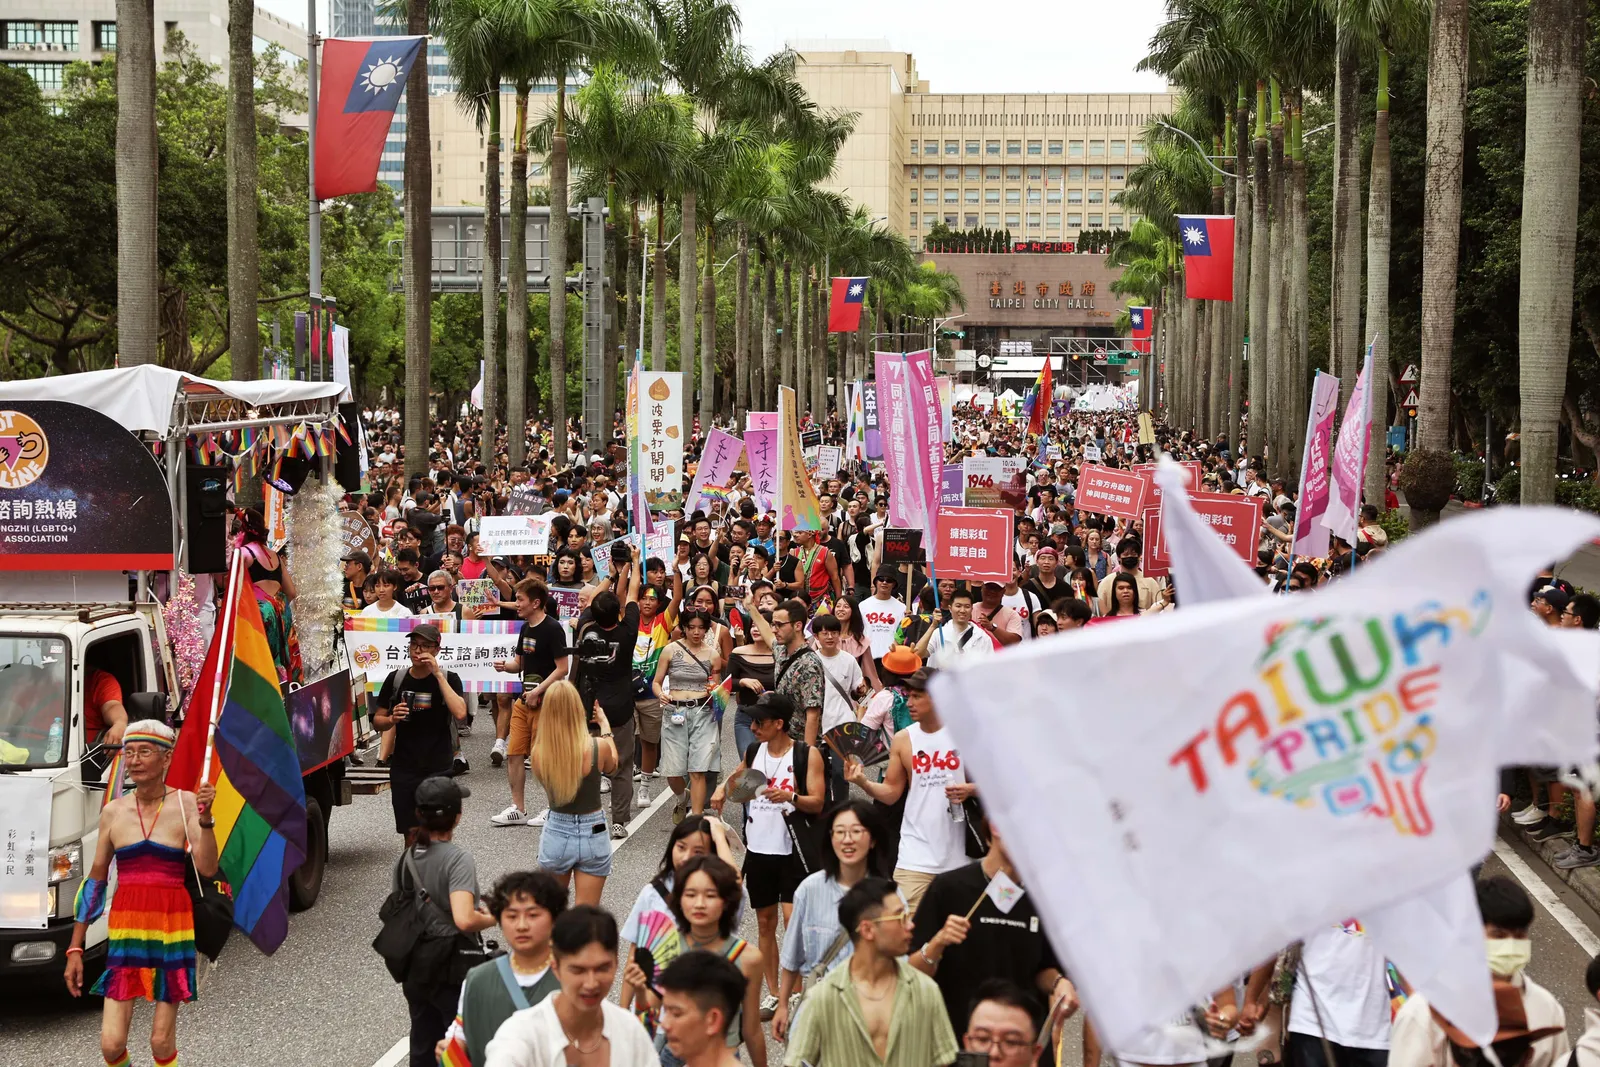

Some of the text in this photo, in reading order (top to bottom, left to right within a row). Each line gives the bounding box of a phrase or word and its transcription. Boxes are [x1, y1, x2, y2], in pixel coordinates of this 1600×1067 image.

[990, 280, 1096, 297] 臺北市政府
[989, 299, 1095, 309] TAIPEI CITY HALL
[967, 474, 994, 488] 1946
[32, 525, 77, 534] (LGBTQ+)
[949, 527, 988, 540] 擁抱彩虹
[4, 535, 69, 543] ASSOCIATION
[885, 541, 911, 553] 1946
[949, 546, 988, 559] 讓愛自由
[1260, 663, 1442, 773] PRIDE
